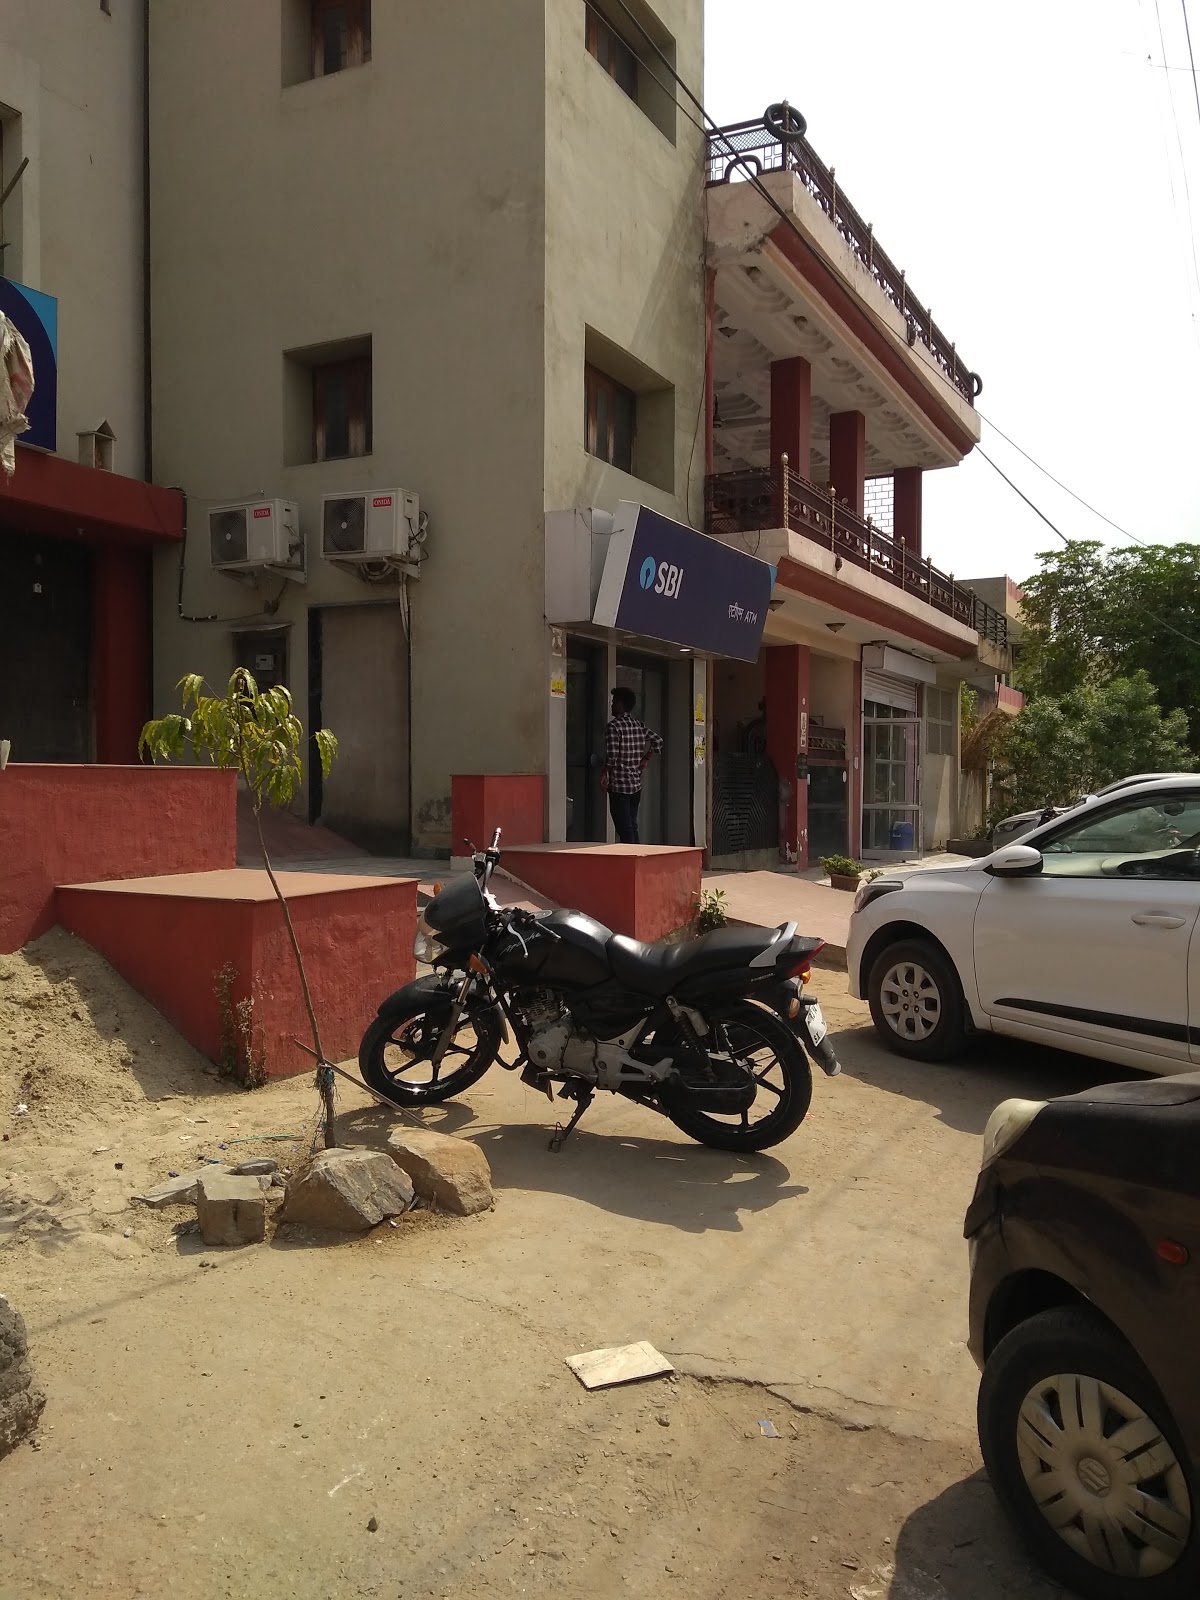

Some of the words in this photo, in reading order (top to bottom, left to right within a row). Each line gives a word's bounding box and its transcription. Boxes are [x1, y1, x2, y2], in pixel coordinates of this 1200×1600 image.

[654, 561, 684, 600] SBI
[728, 602, 744, 621] एटीएम
[744, 610, 758, 625] ATM
